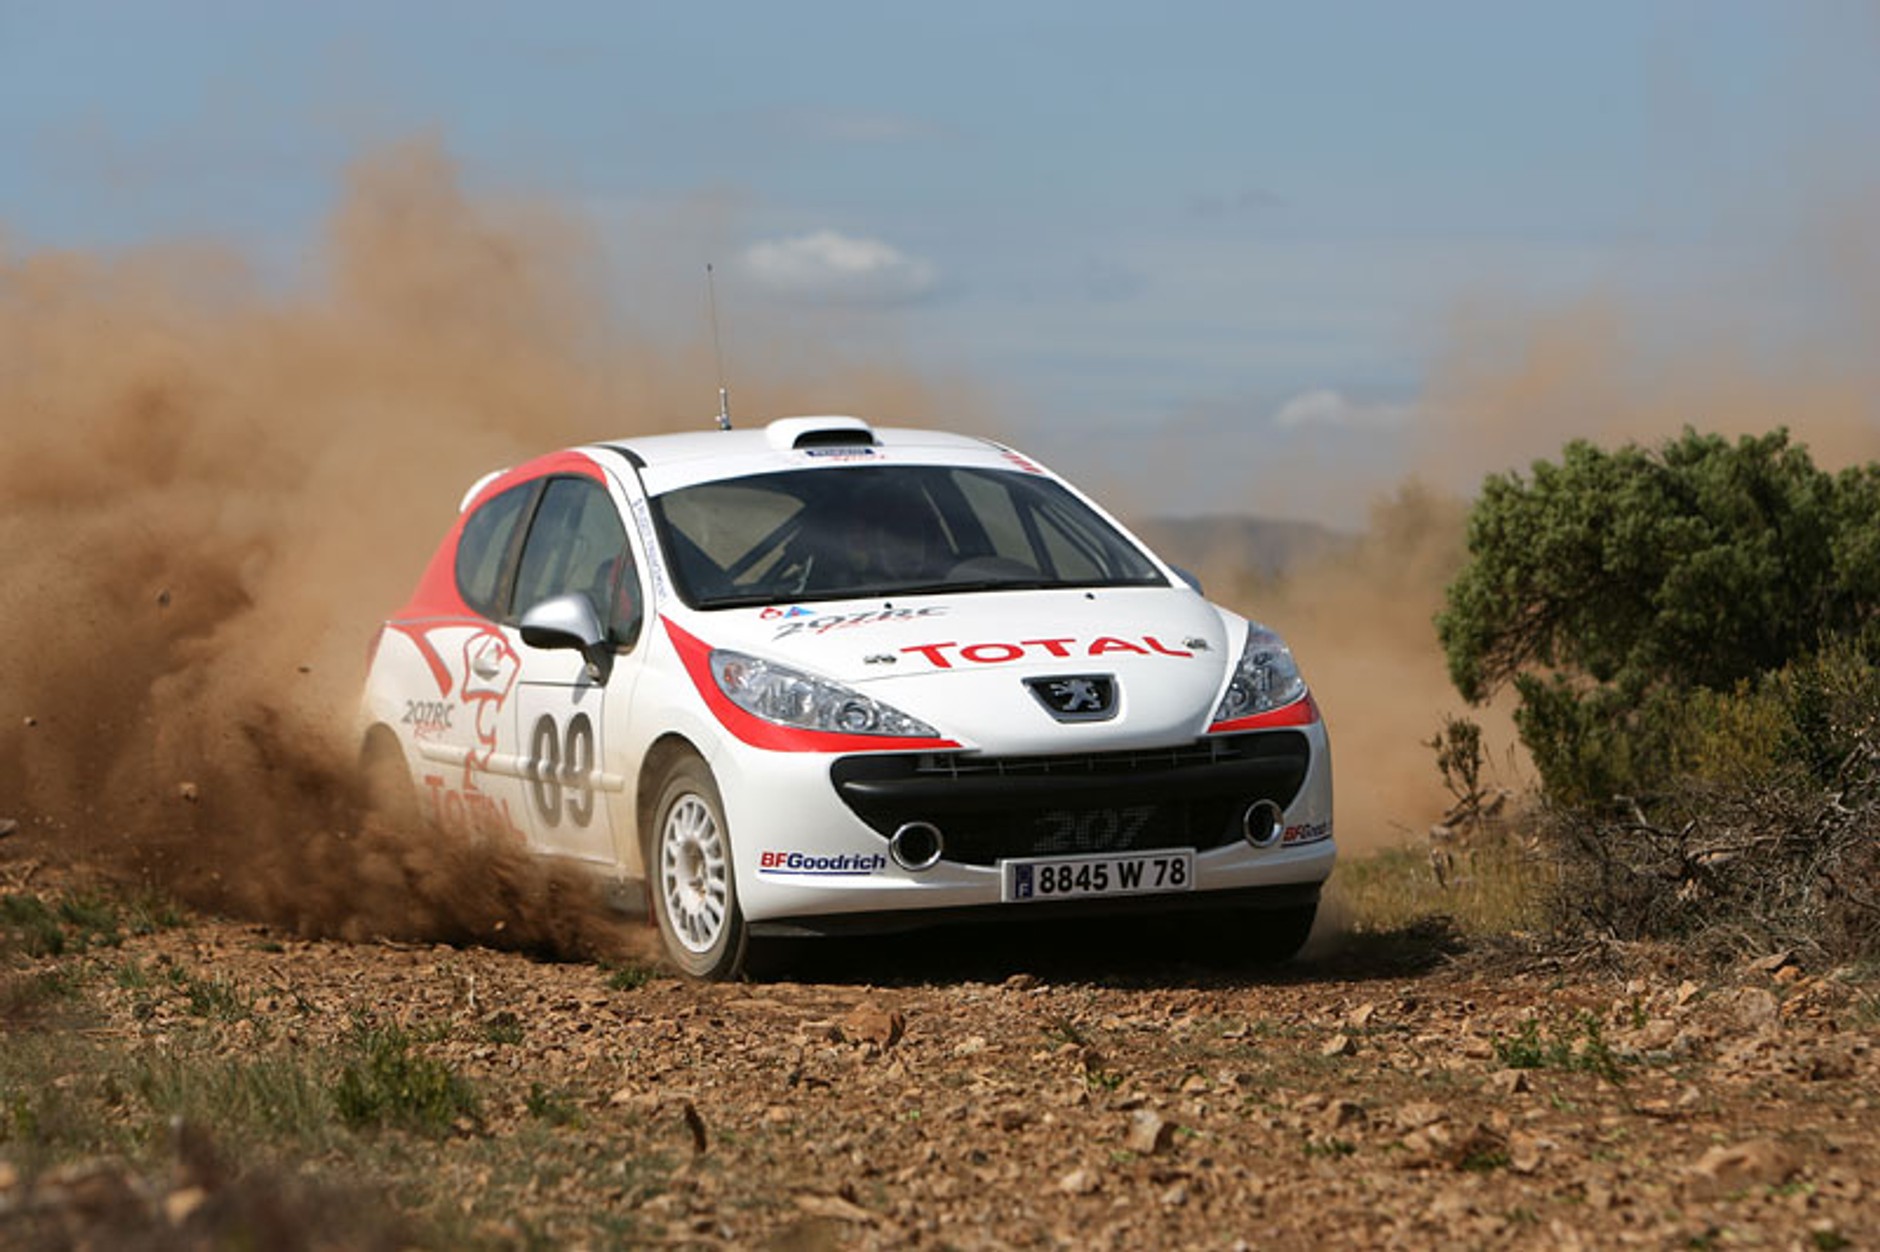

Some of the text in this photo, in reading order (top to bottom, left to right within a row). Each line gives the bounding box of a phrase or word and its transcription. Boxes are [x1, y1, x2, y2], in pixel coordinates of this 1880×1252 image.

[900, 636, 1194, 668] TOTAL
[401, 699, 455, 728] 207RC
[532, 711, 594, 829] 09
[1034, 806, 1158, 853] 207
[760, 852, 886, 870] BFGoodrich
[1039, 863, 1109, 894] 8845
[1118, 859, 1145, 889] W
[1153, 857, 1186, 887] 78
